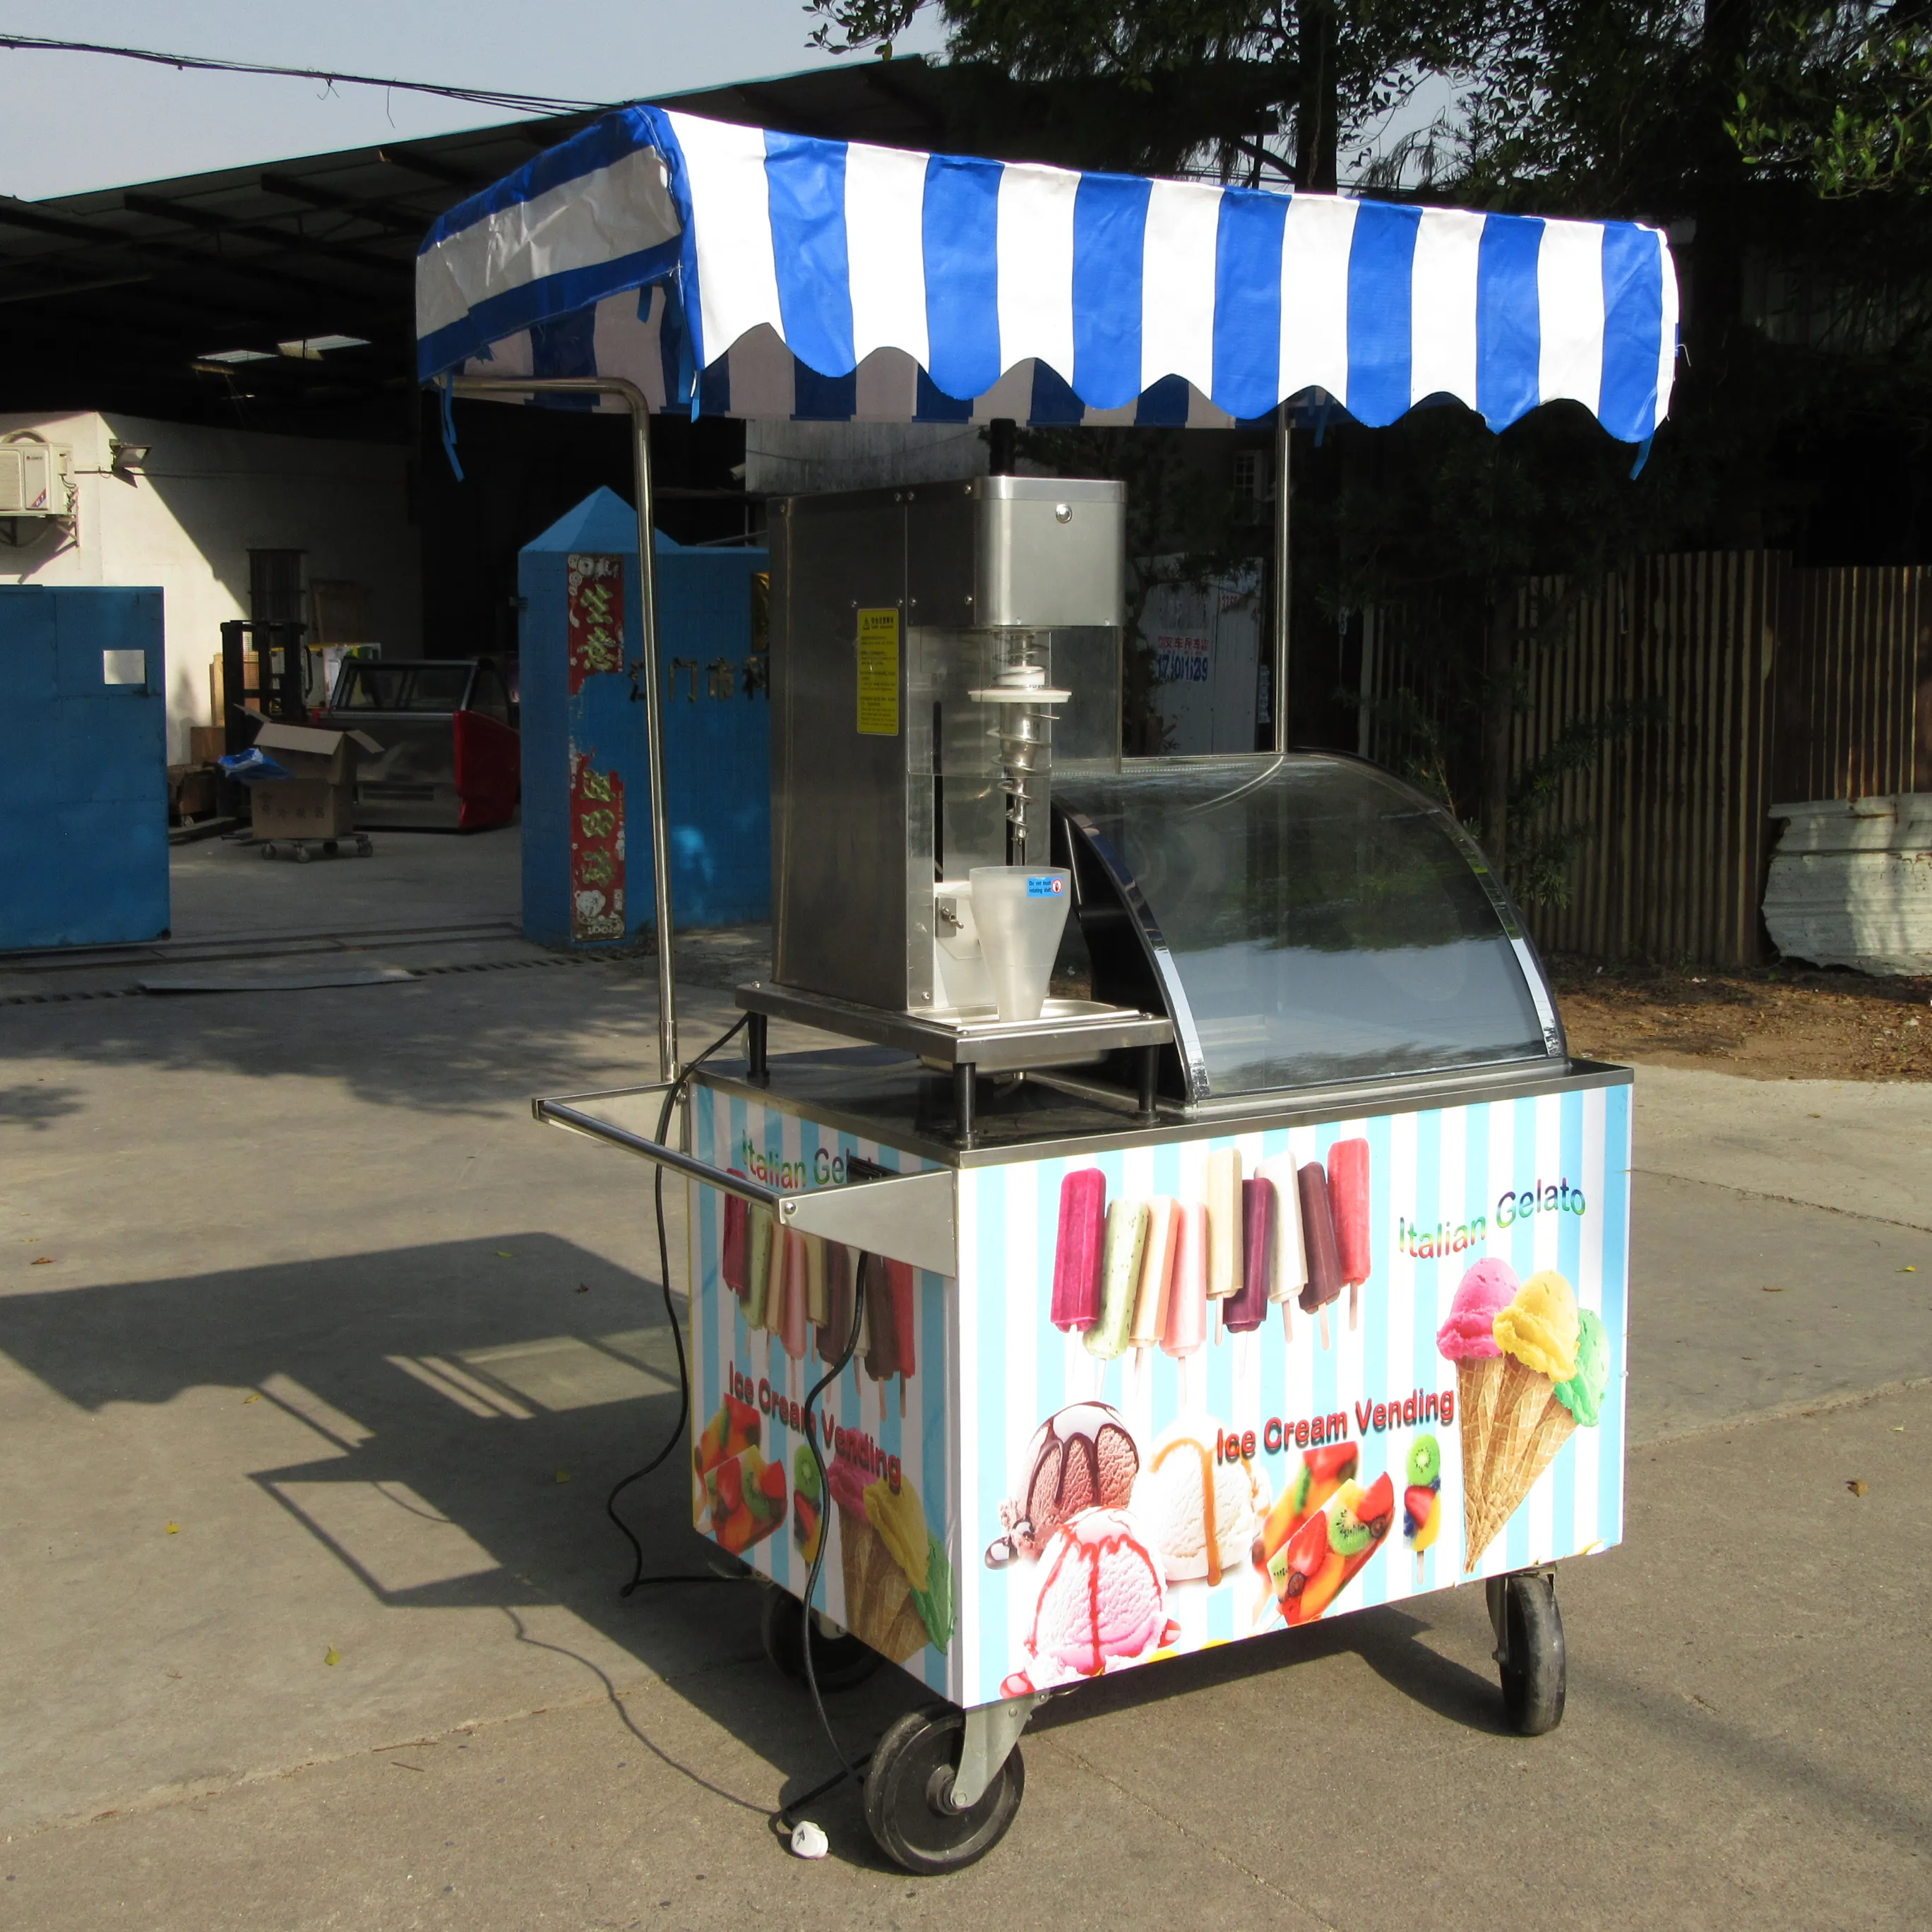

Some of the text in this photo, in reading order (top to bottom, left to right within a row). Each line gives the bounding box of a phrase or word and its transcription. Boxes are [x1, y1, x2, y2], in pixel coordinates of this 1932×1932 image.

[742, 1129, 807, 1188] Italian
[1399, 1177, 1586, 1258] Italian Gelato
[729, 1360, 755, 1406] Ice
[821, 1409, 902, 1494] Vending
[1217, 1388, 1455, 1462] Ice Cream Vending
